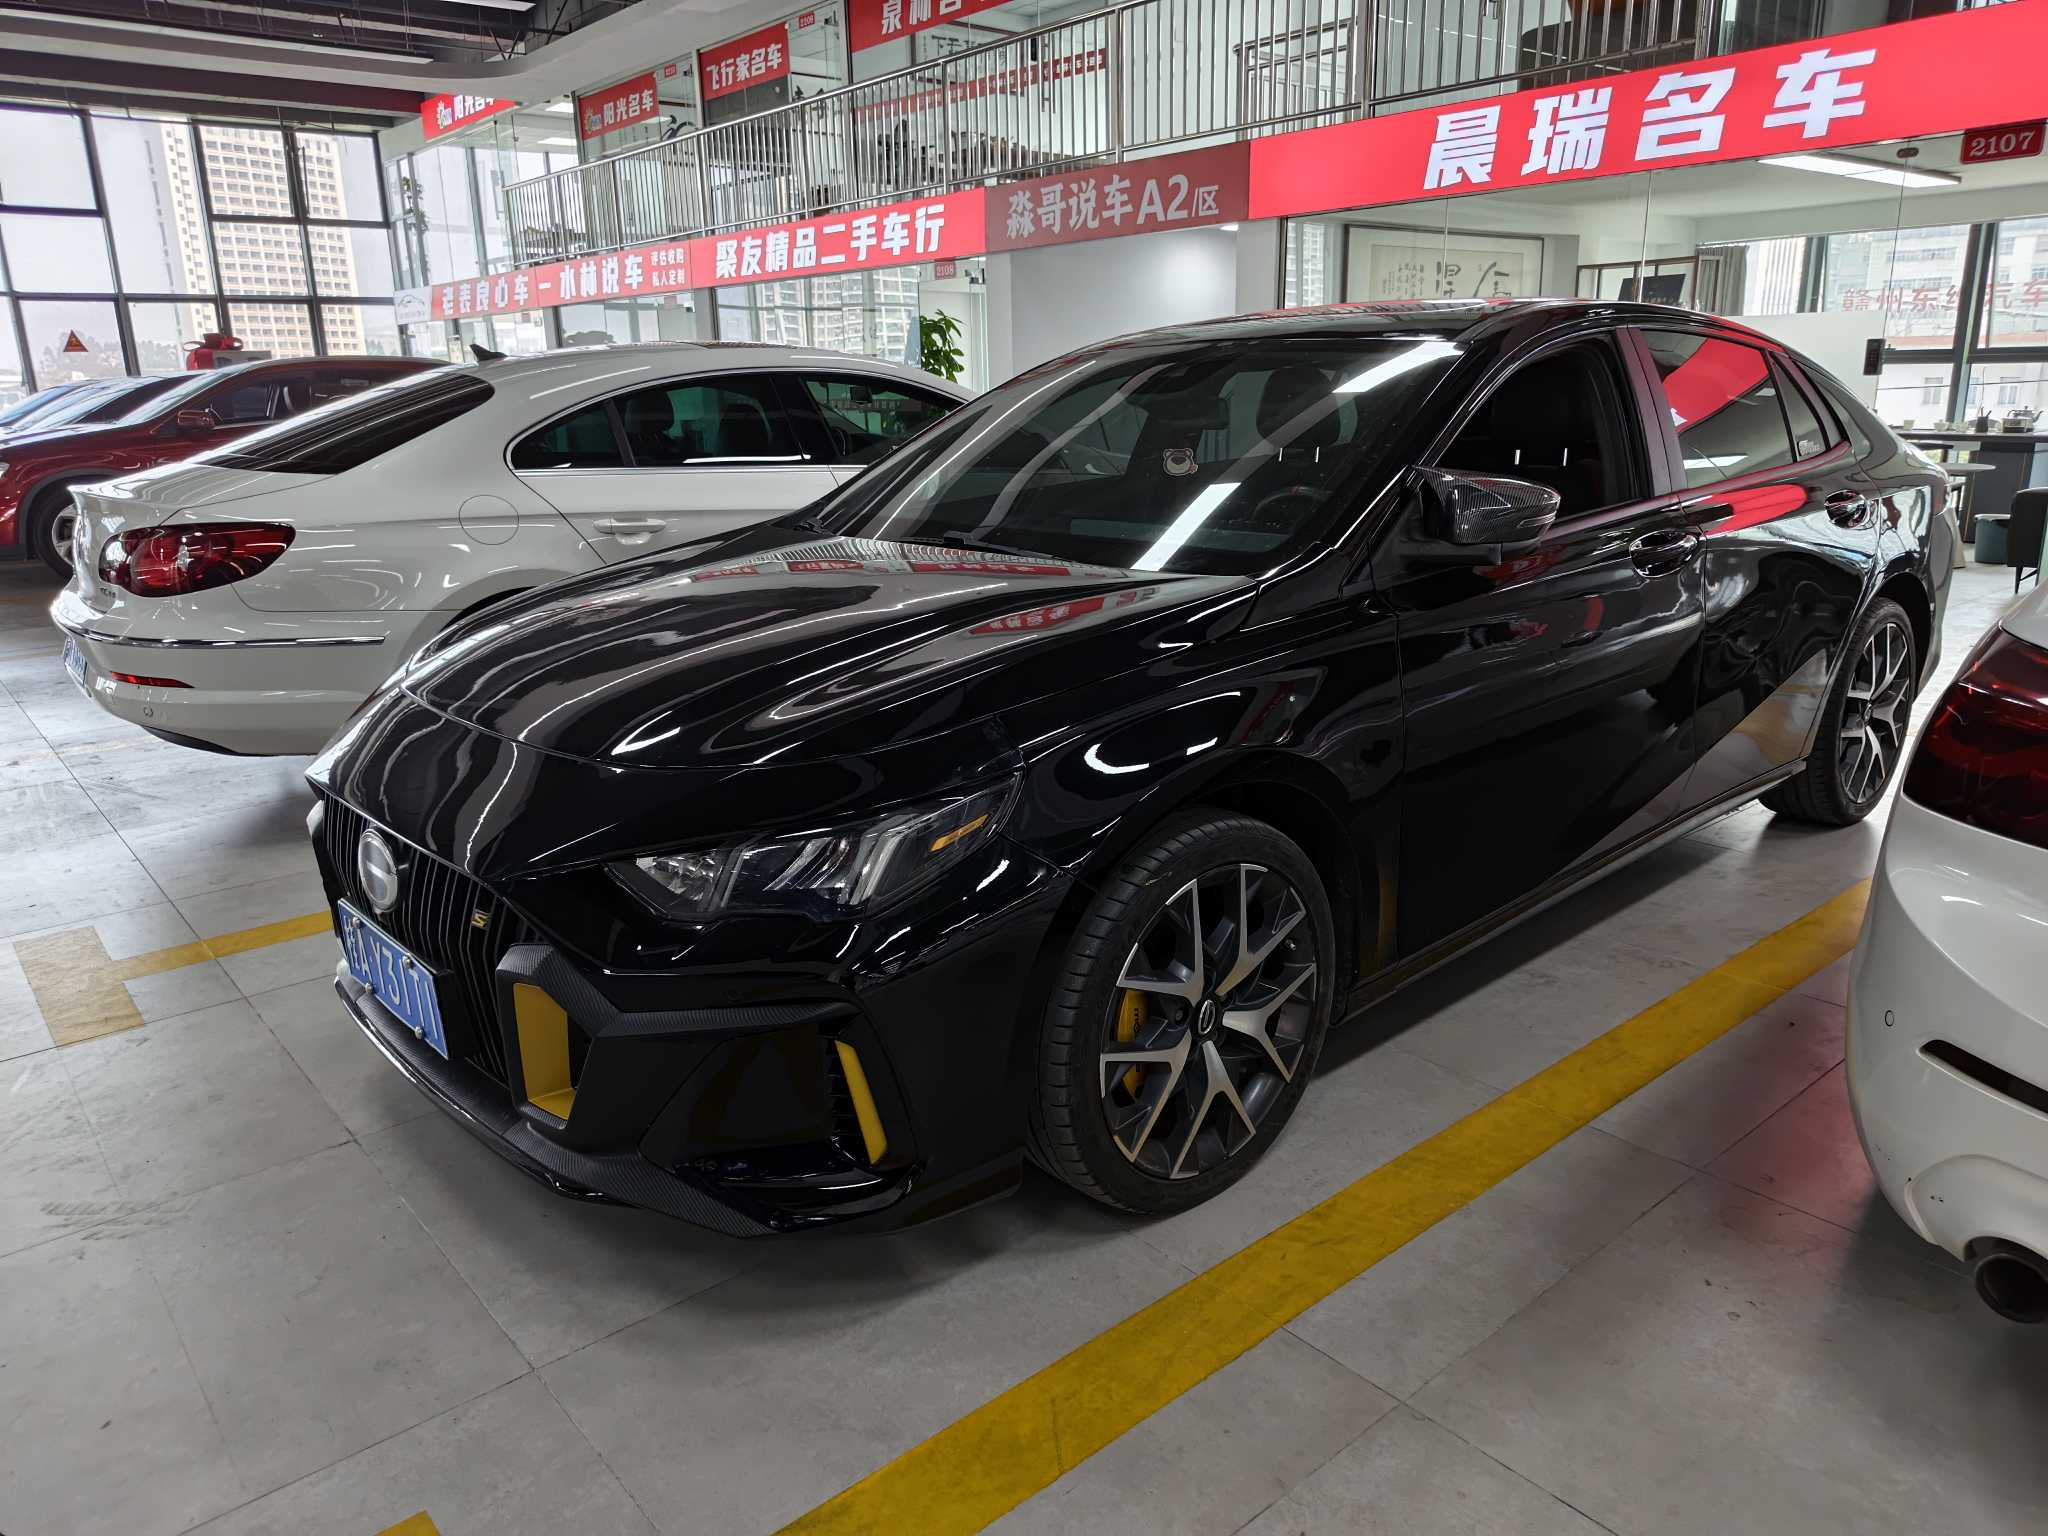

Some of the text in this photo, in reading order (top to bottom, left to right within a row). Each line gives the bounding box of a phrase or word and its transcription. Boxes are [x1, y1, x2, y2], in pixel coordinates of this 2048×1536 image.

[706, 43, 783, 90] 飞行家名车
[603, 89, 654, 126] 阳光名车
[1423, 47, 1877, 191] 晨瑞名车
[1969, 130, 2036, 158] 2107
[714, 203, 946, 280] 聚友精品二手车行
